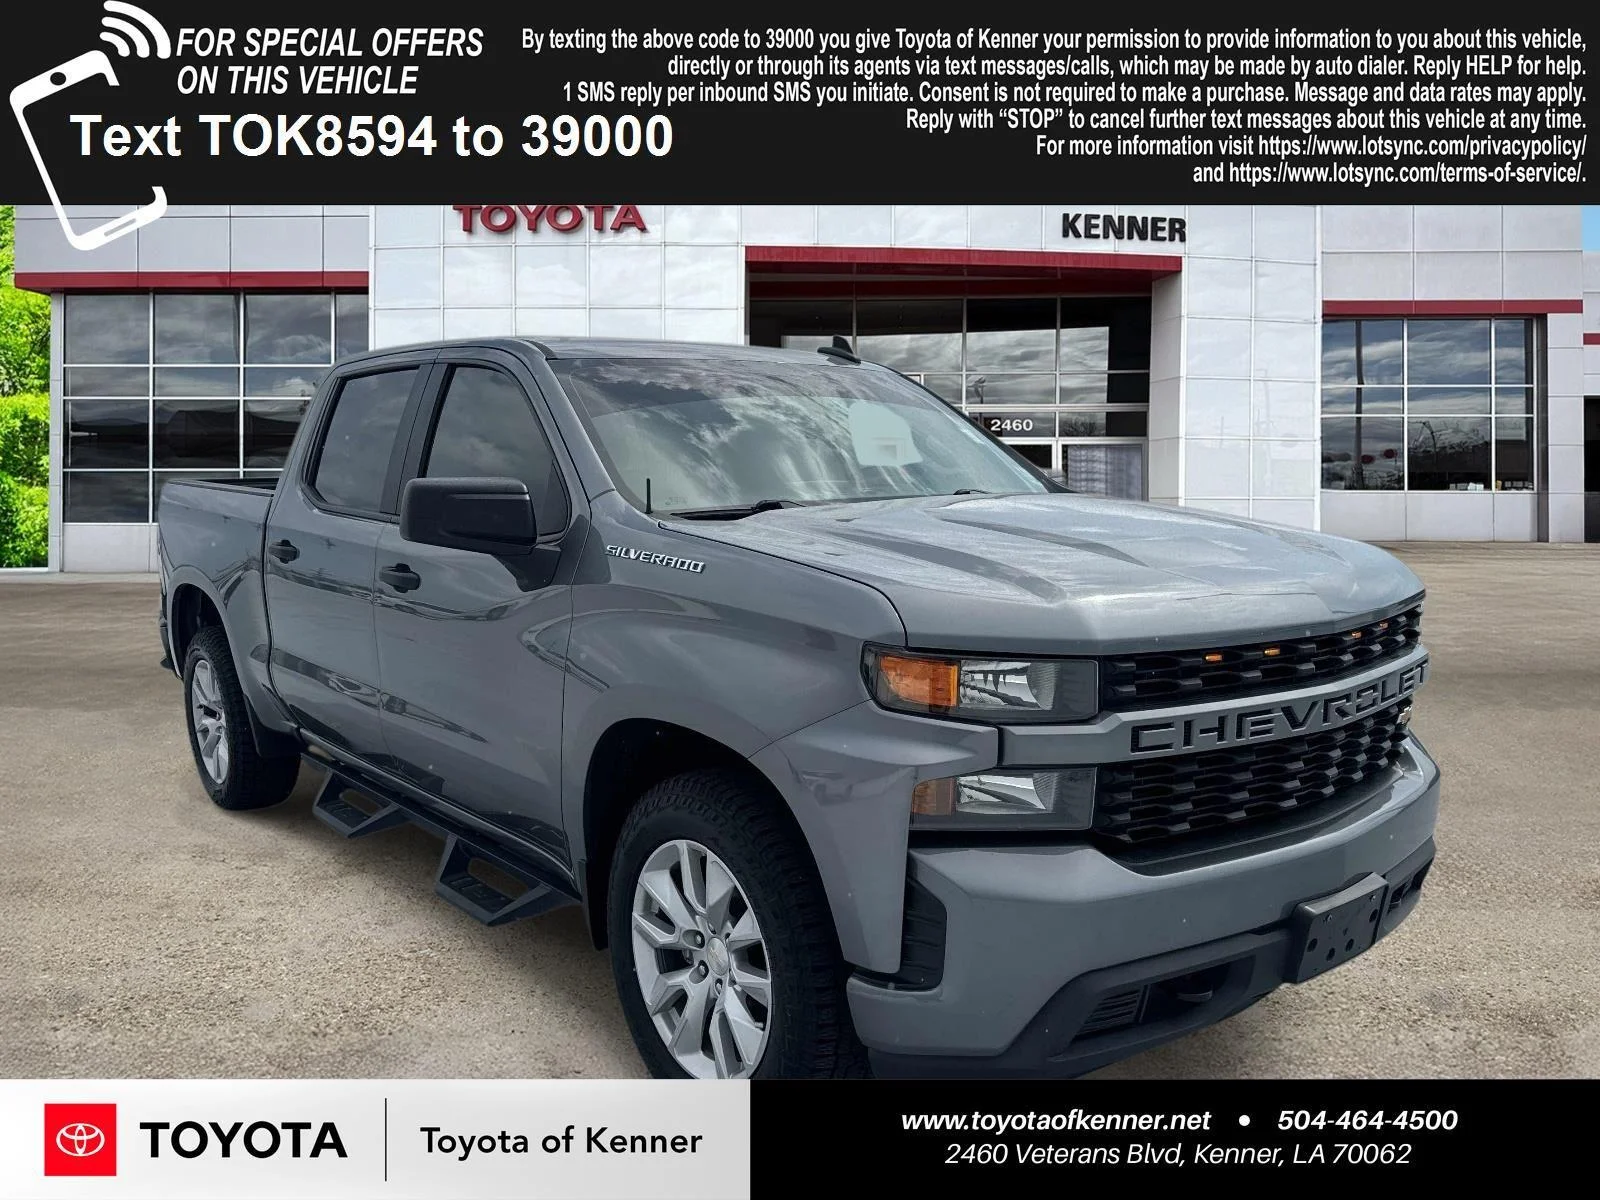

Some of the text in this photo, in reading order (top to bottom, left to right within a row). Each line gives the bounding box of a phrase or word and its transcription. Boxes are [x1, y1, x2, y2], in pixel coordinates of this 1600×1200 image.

[453, 205, 648, 233] TOYOTA
[1062, 213, 1187, 243] KENNER
[990, 418, 1034, 432] 2460
[605, 544, 706, 574] SILVERADO
[1130, 655, 1429, 755] CHEVROLET
